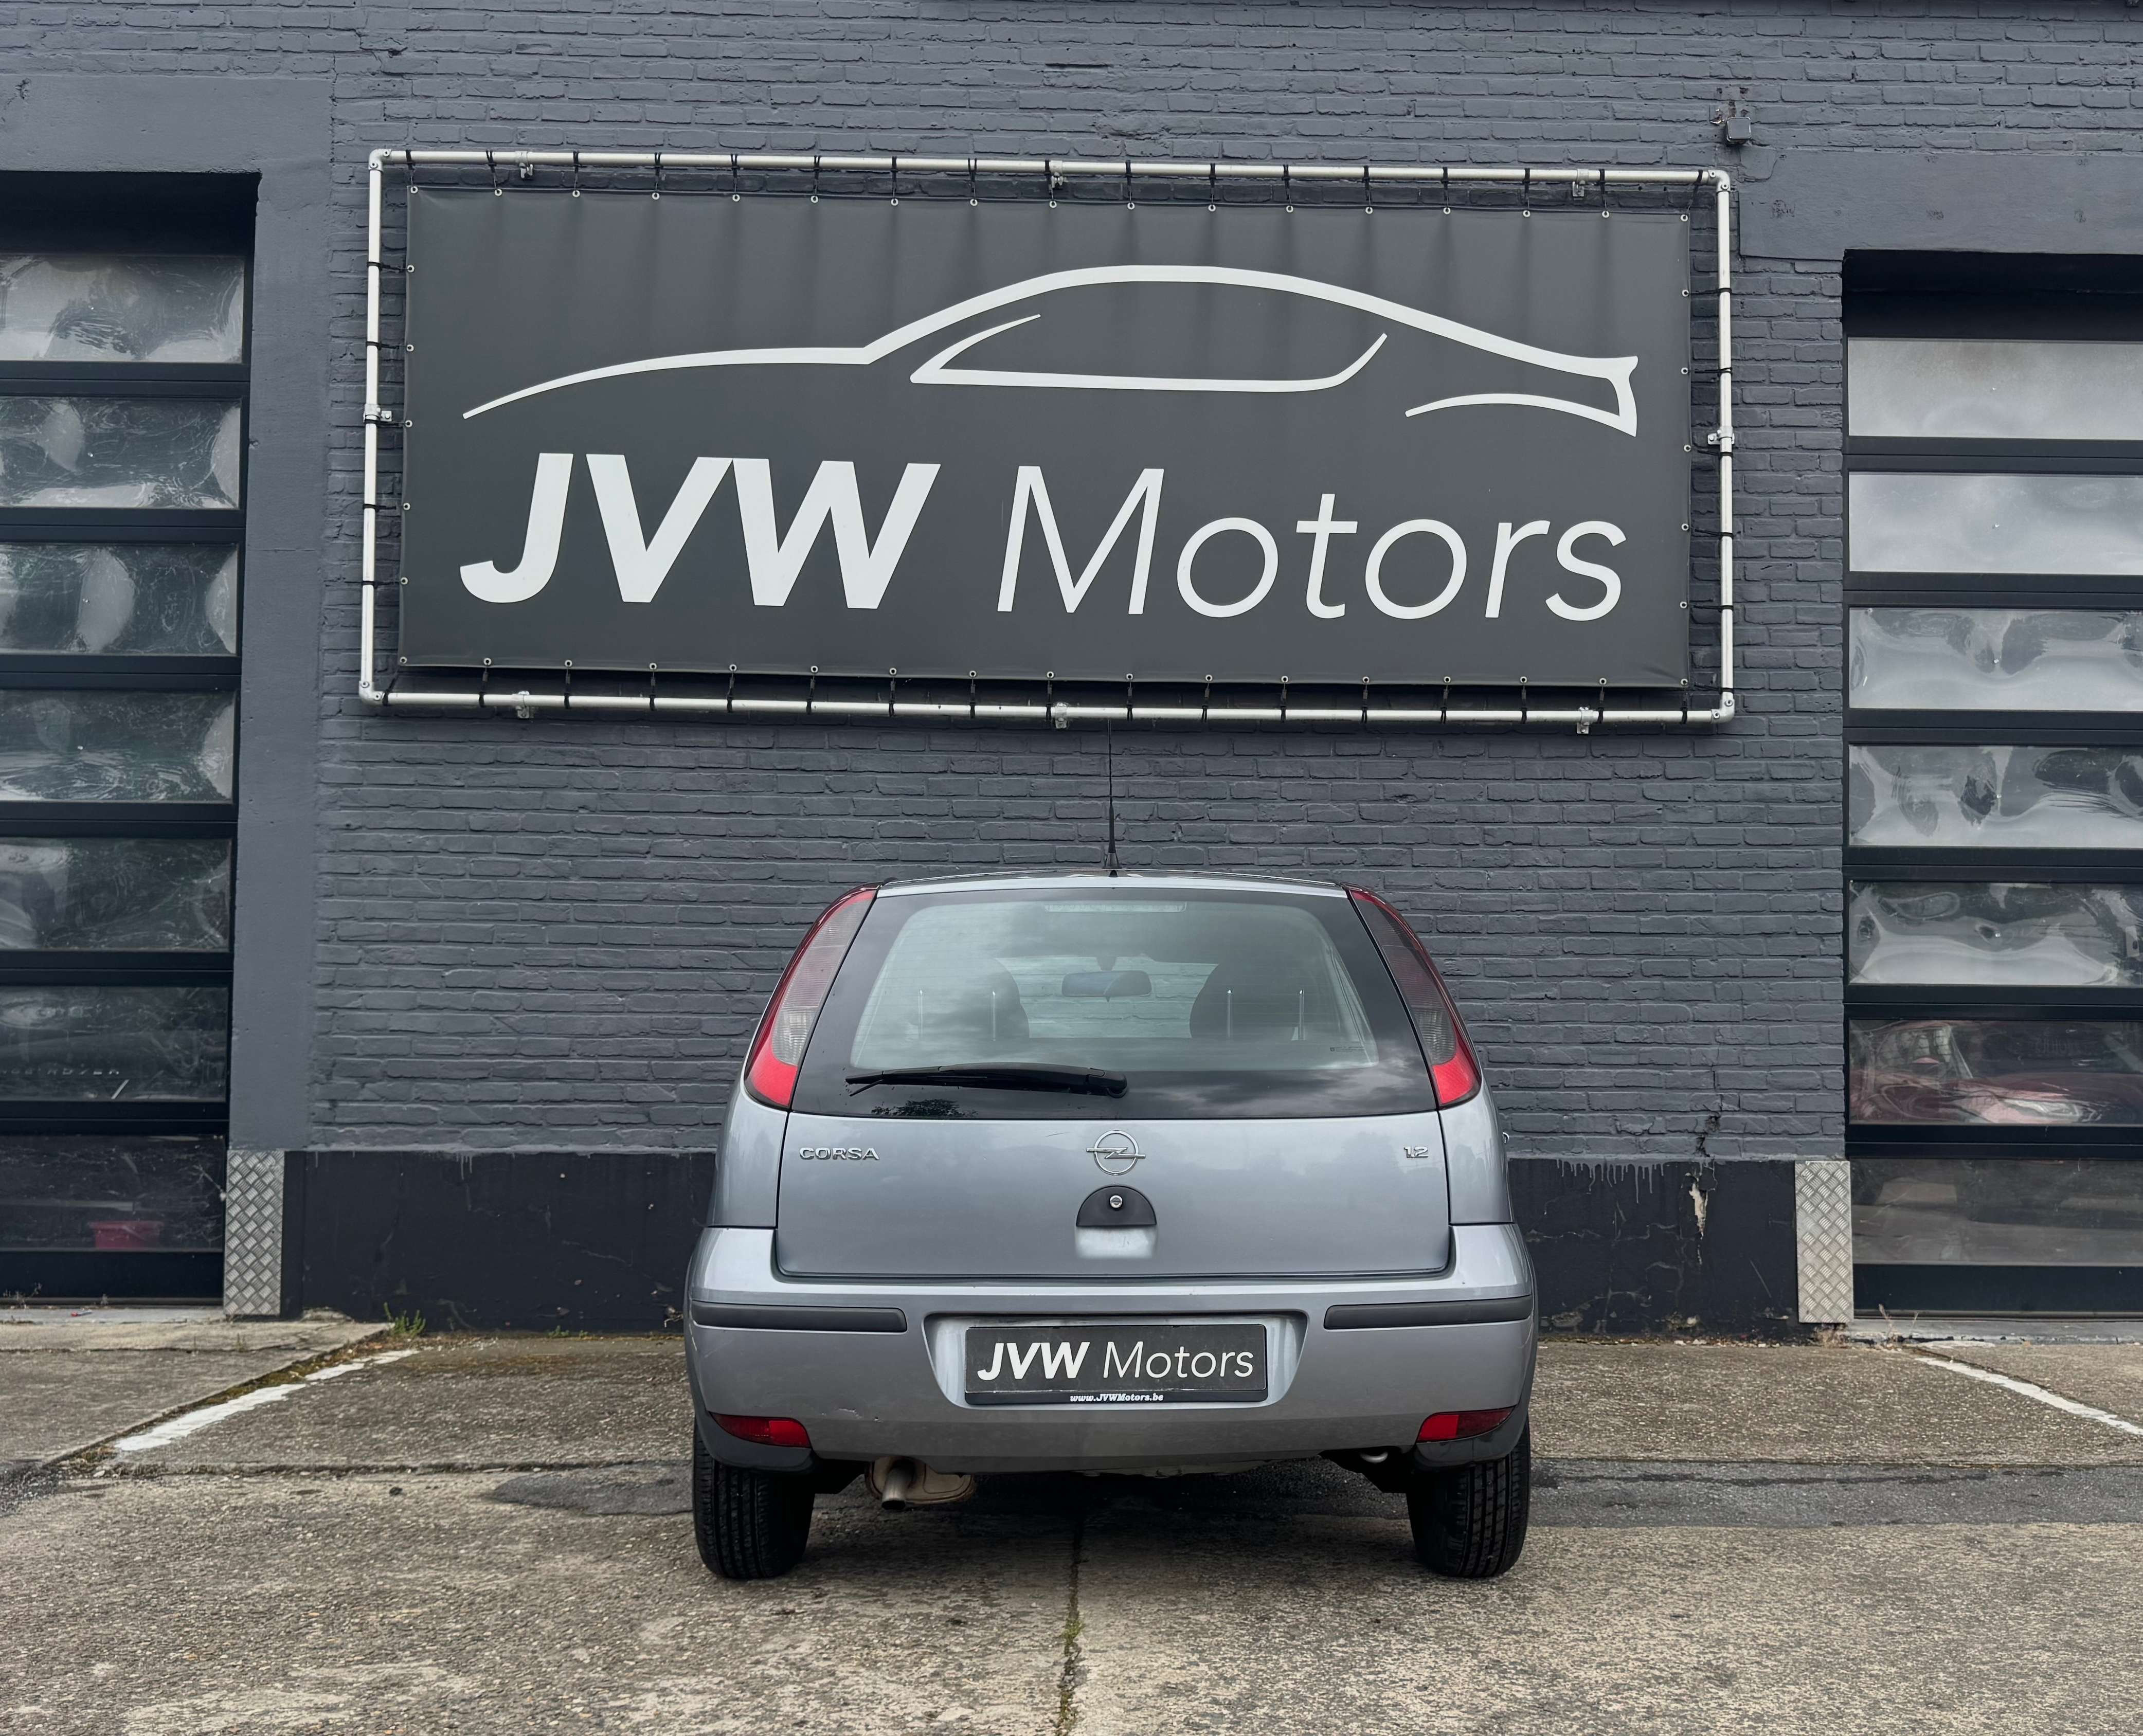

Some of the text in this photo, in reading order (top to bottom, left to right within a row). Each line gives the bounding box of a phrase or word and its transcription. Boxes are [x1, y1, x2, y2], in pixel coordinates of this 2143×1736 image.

[460, 453, 1627, 622] JVW Motors
[799, 1147, 880, 1160] CORSA
[977, 1341, 1254, 1381] JVW Motors
[1070, 1393, 1164, 1402] www.JVWMotors.be
